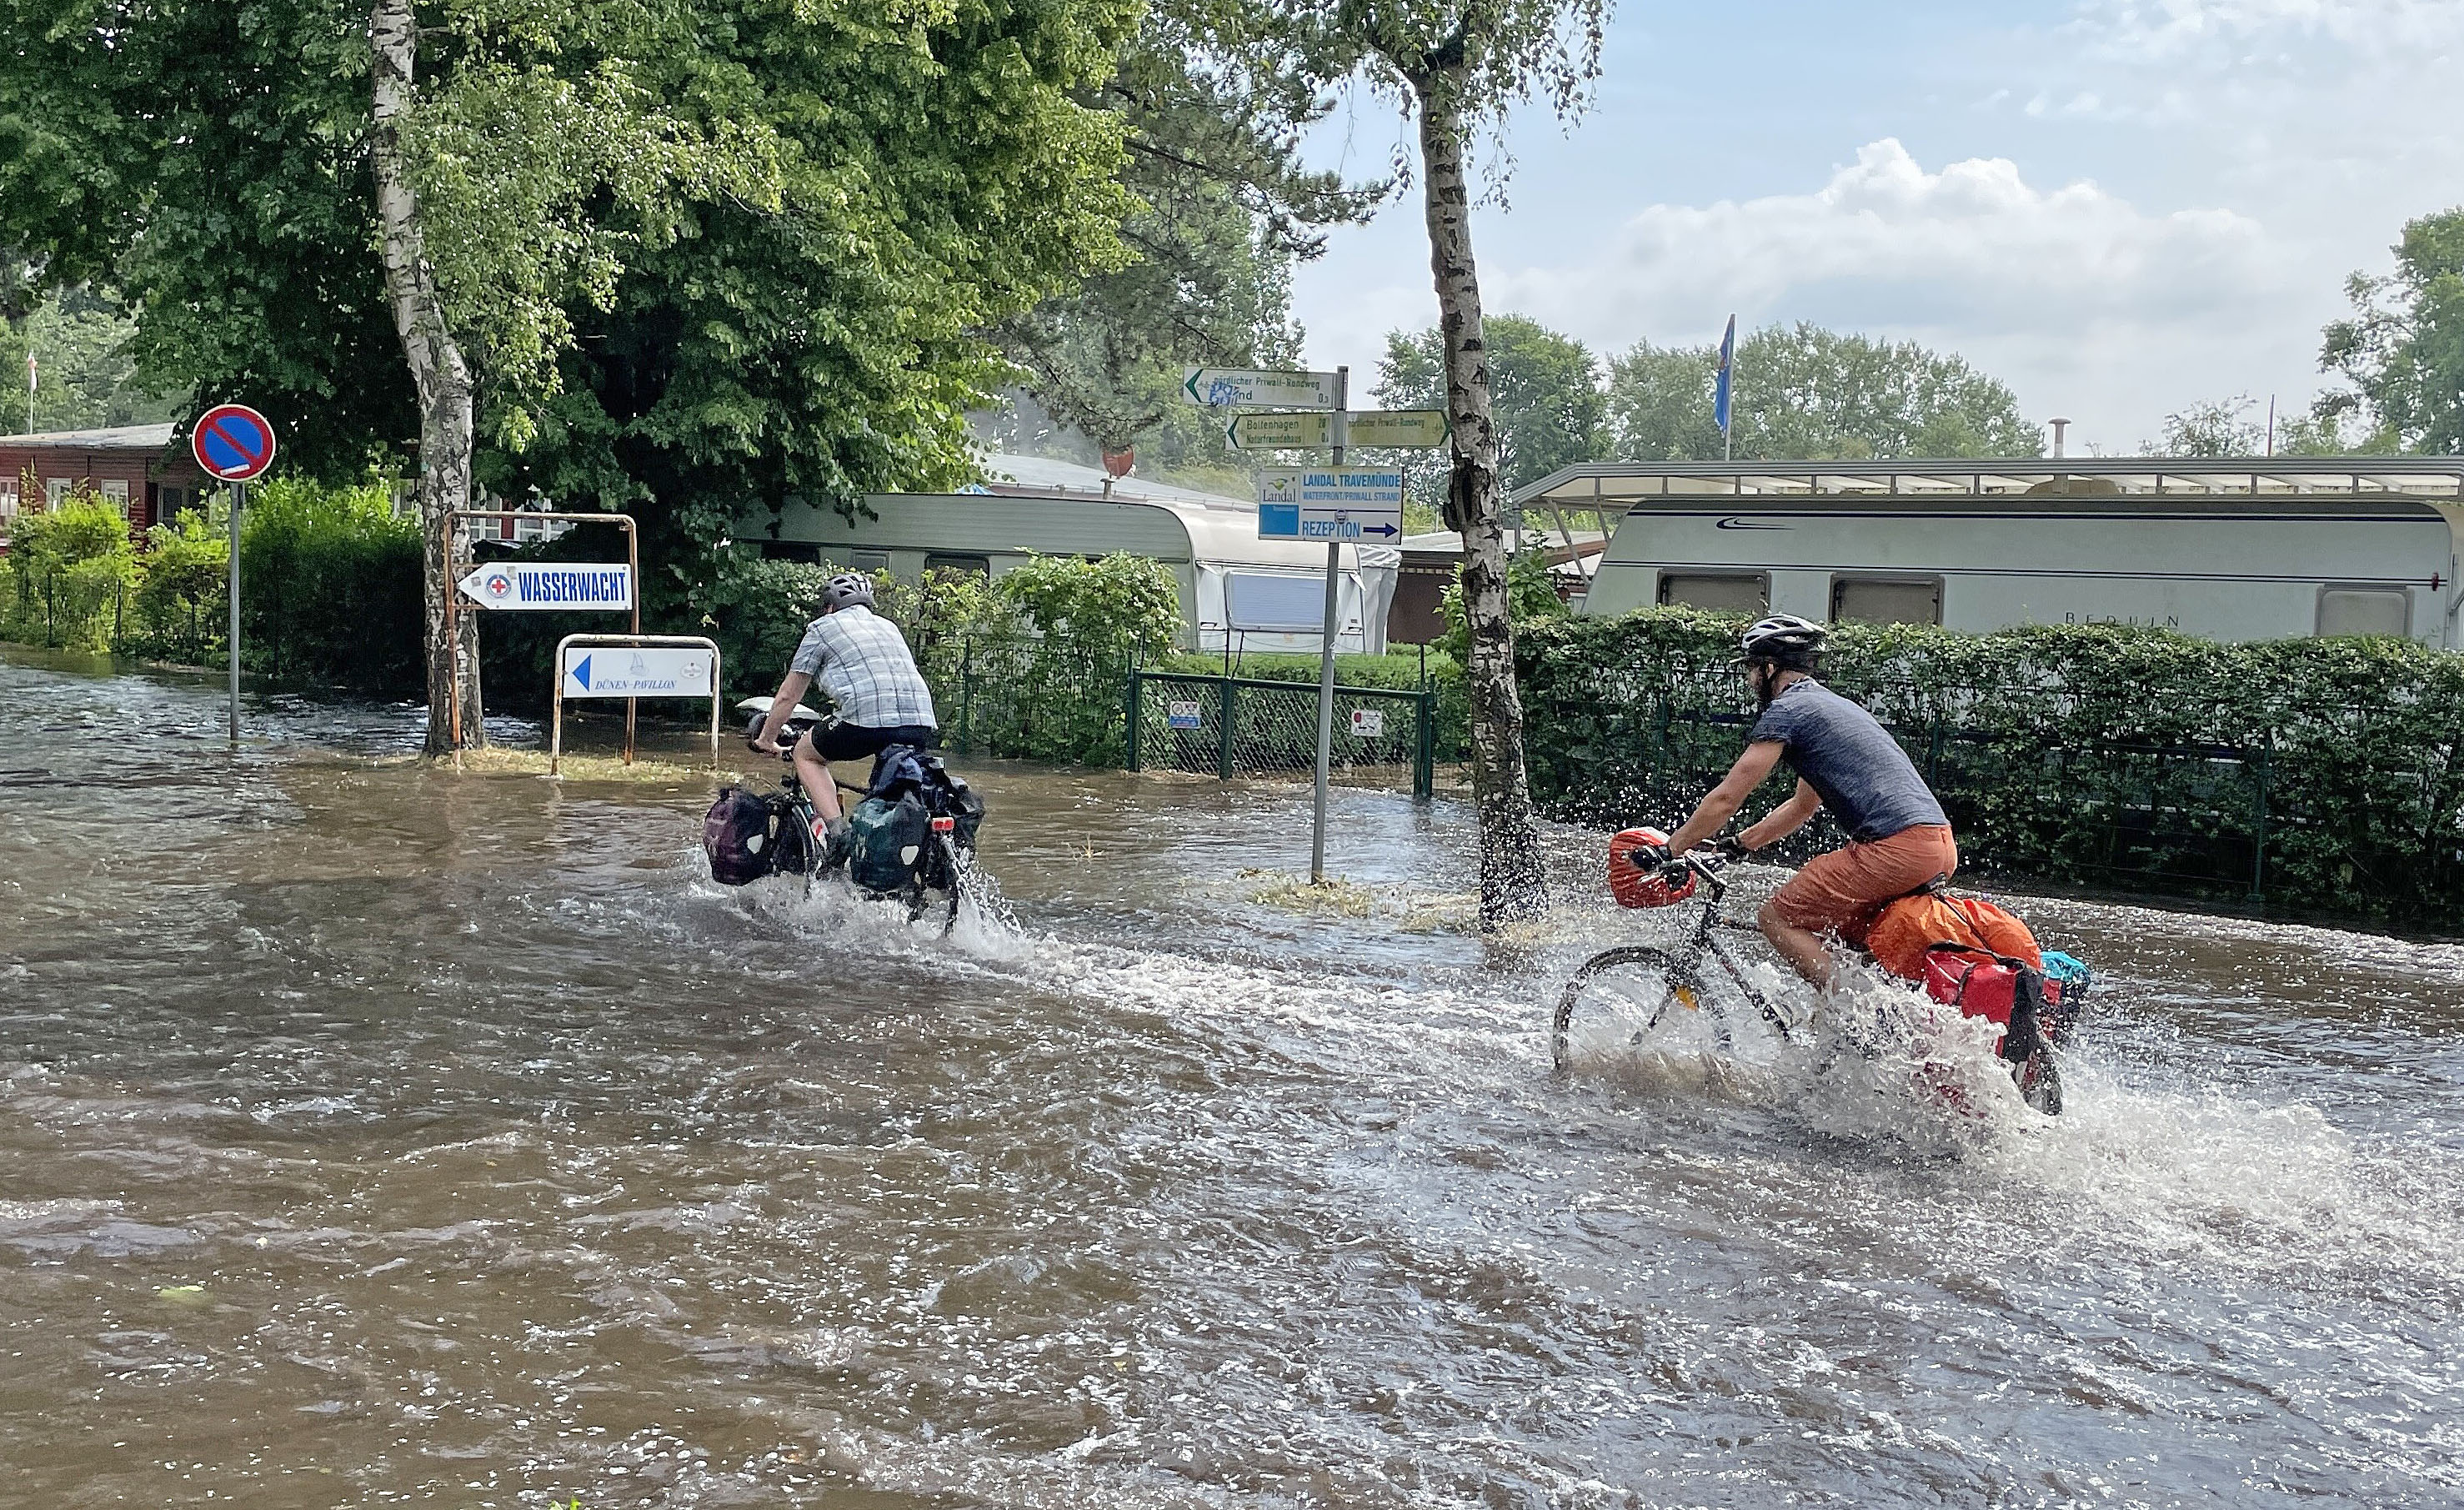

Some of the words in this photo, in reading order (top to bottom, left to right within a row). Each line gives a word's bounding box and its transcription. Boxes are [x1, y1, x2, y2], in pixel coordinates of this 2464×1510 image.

[1214, 376, 1253, 386] nördlicher
[1246, 419, 1300, 431] Boltenhagen
[1303, 474, 1337, 487] LANDAL
[1339, 472, 1400, 488] TRAVEMÜNDE
[1263, 489, 1296, 503] Landal
[1374, 492, 1400, 501] STRAND
[1302, 520, 1360, 538] REZEPTION
[518, 572, 626, 602] WASSERWACHT
[2066, 612, 2179, 627] BEDUIN
